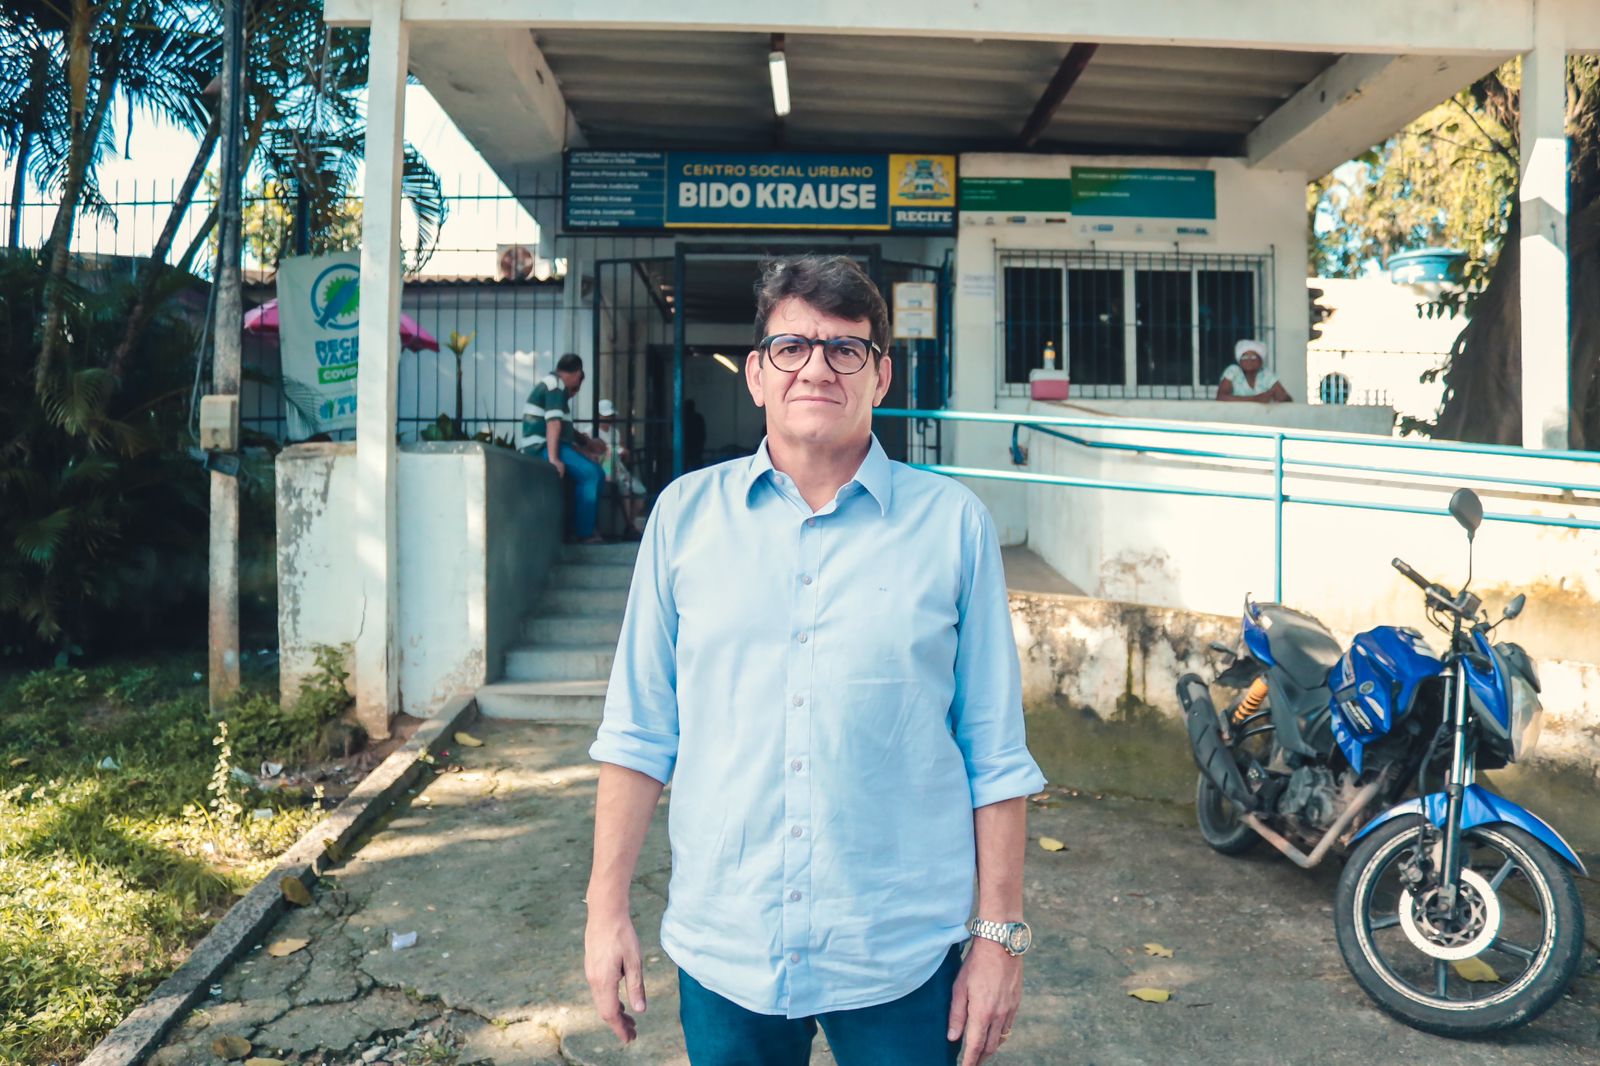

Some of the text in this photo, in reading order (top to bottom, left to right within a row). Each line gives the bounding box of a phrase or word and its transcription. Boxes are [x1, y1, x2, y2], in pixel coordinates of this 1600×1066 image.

[683, 164, 873, 178] CENTRO SOCIAL URBANO
[679, 182, 876, 210] BIDO KRAUSE
[896, 211, 952, 222] RECIFE
